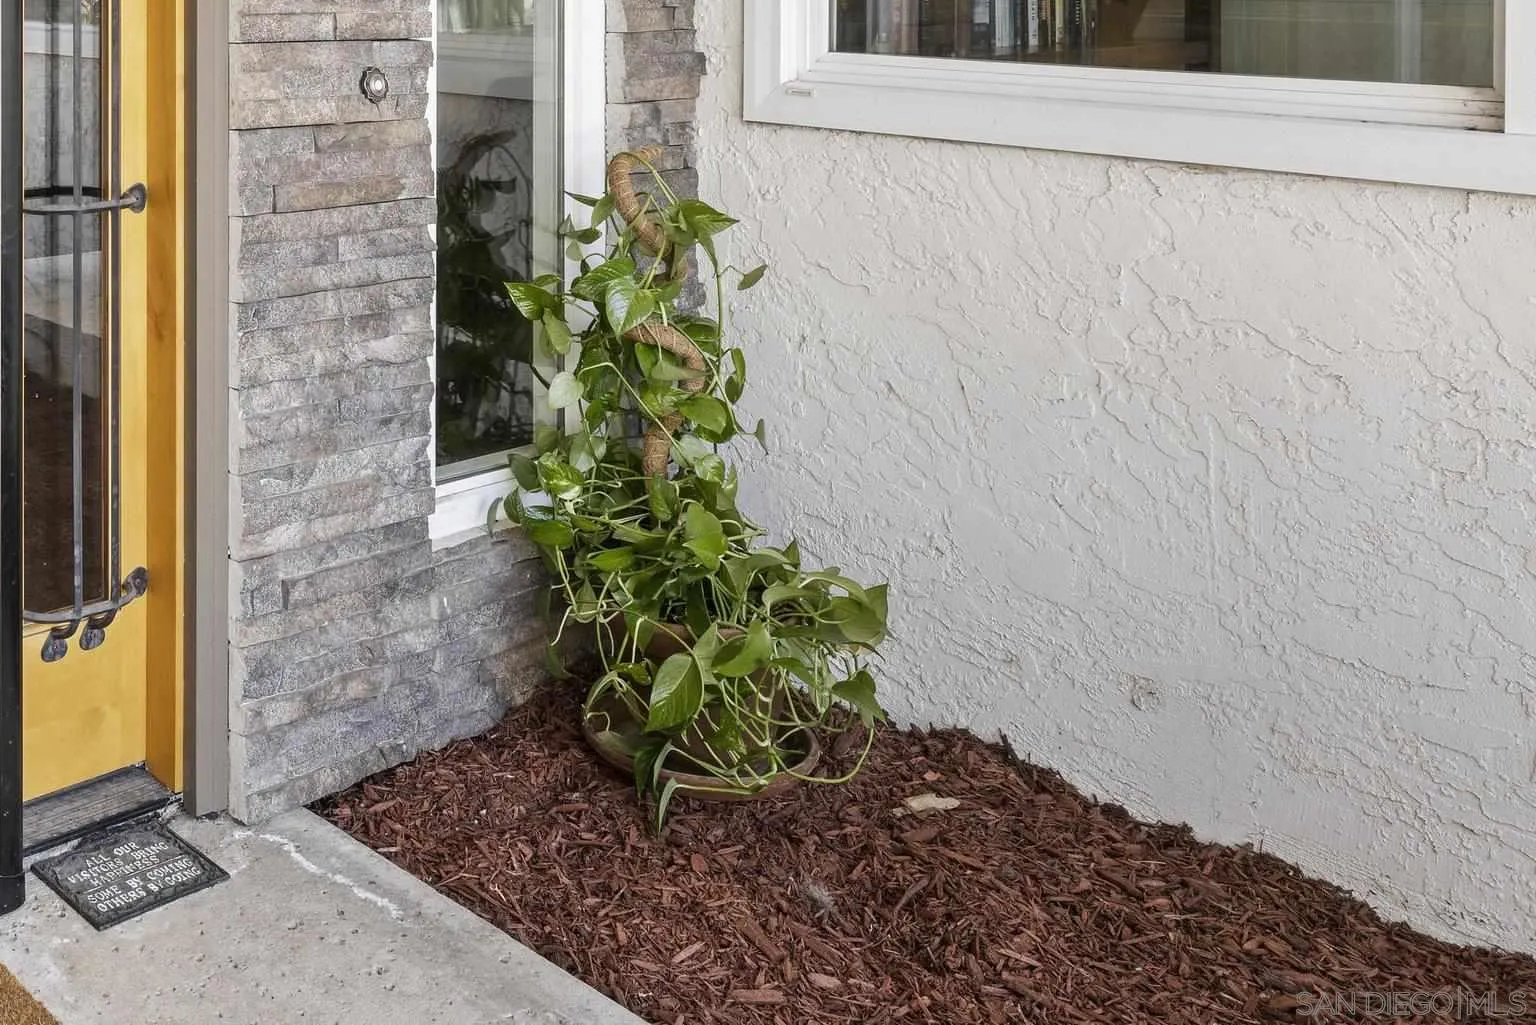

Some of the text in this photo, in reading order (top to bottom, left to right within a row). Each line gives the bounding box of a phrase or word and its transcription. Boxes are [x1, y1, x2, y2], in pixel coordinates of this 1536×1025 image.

[67, 842, 169, 884] VISITORS BRING
[86, 842, 140, 868] ALL OUR
[90, 855, 160, 887] HAPPINESS
[88, 857, 193, 904] SOME BY COMING
[96, 866, 201, 912] OTHERS BY GOING
